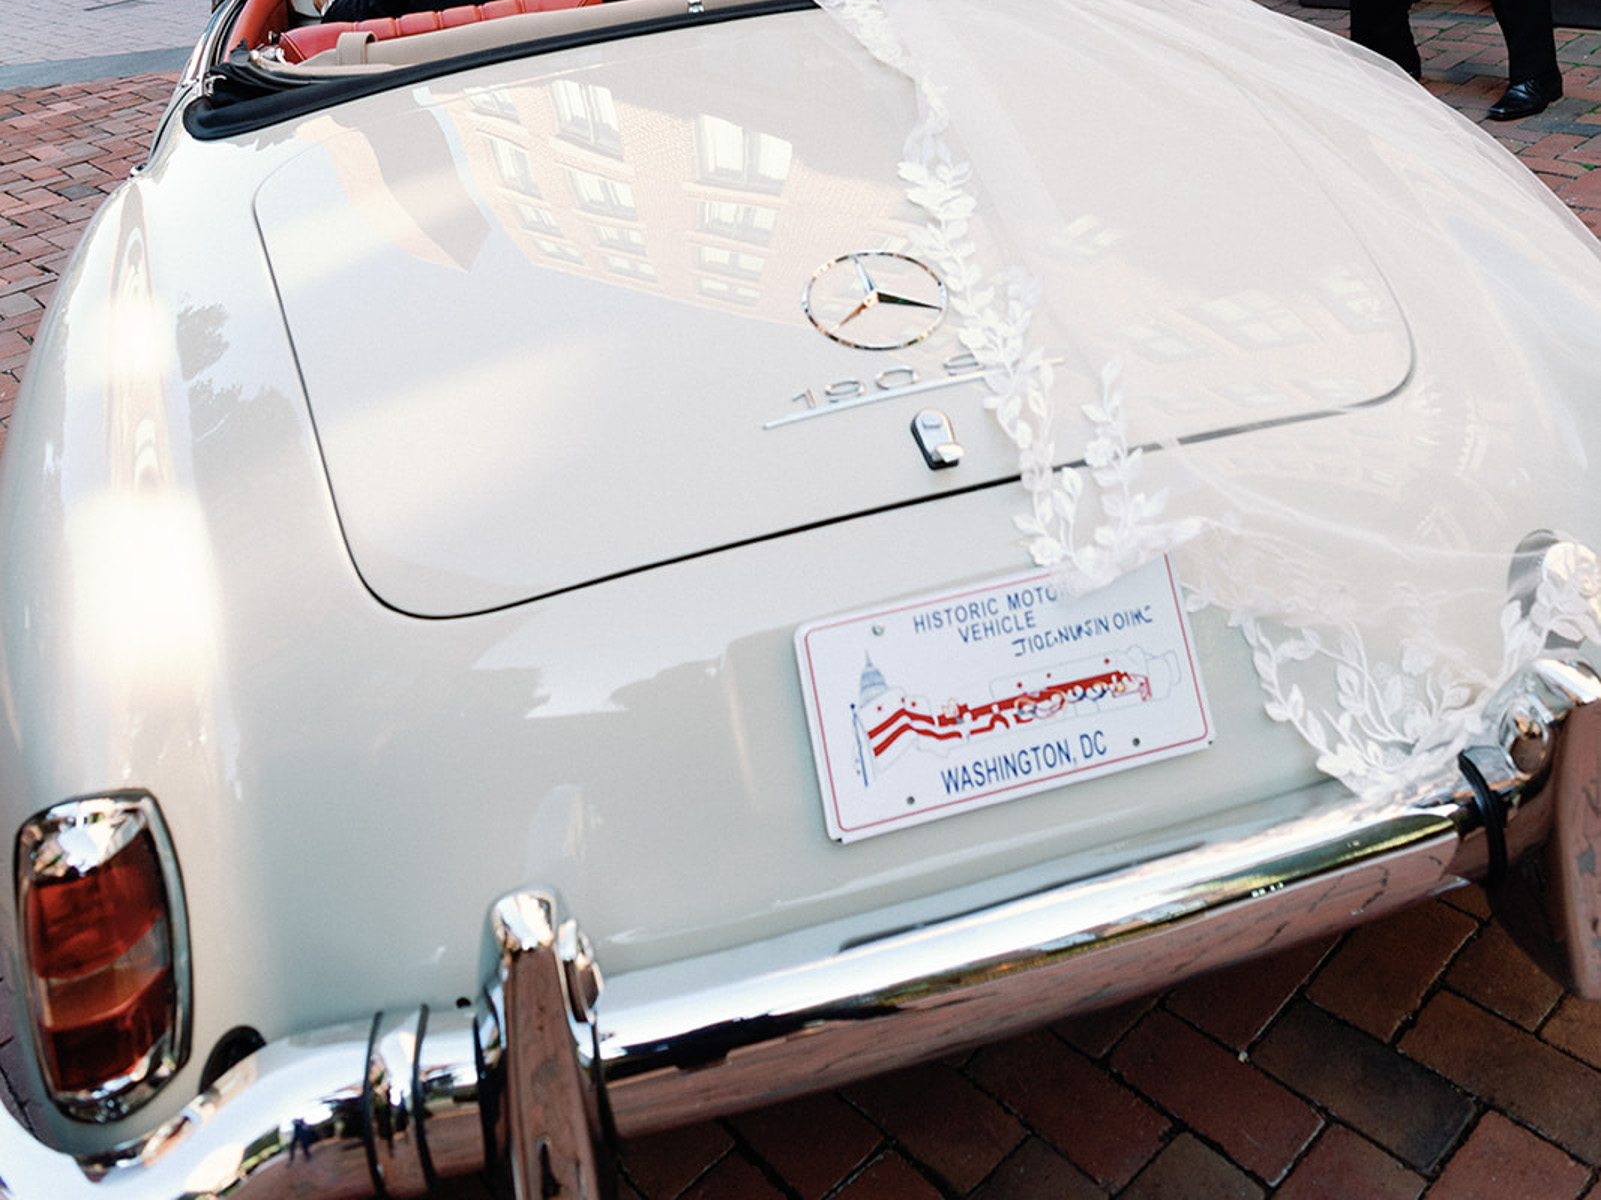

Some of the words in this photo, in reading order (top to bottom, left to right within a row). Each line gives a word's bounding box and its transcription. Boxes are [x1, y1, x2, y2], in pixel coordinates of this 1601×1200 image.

[792, 365, 920, 410] 190
[912, 597, 998, 636] HISTORIC
[1007, 585, 1060, 612] MOTO
[957, 609, 1037, 644] VEHICLE
[939, 737, 1079, 795] WASHINGTON,
[1080, 729, 1107, 760] DC
